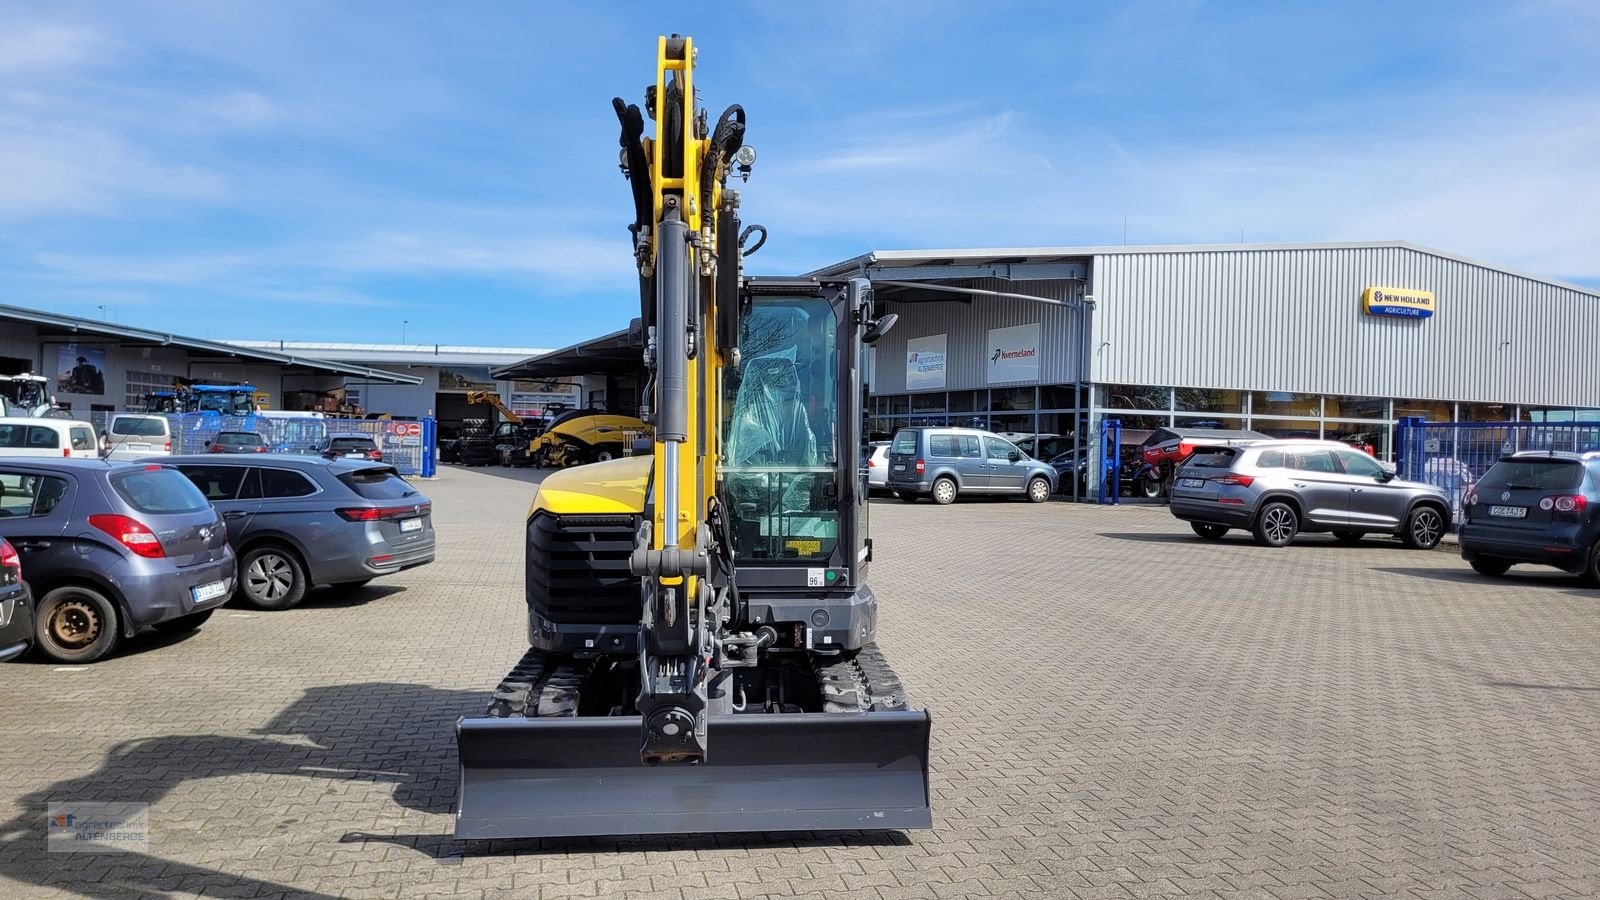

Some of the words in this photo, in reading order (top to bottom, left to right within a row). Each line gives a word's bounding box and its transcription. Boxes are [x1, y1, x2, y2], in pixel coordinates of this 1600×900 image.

[1384, 294, 1399, 303] NEW
[1400, 295, 1430, 305] HOLLAND
[1384, 306, 1420, 316] AGRICULTURE
[1001, 347, 1035, 360] Kverneland
[809, 576, 818, 586] 96
